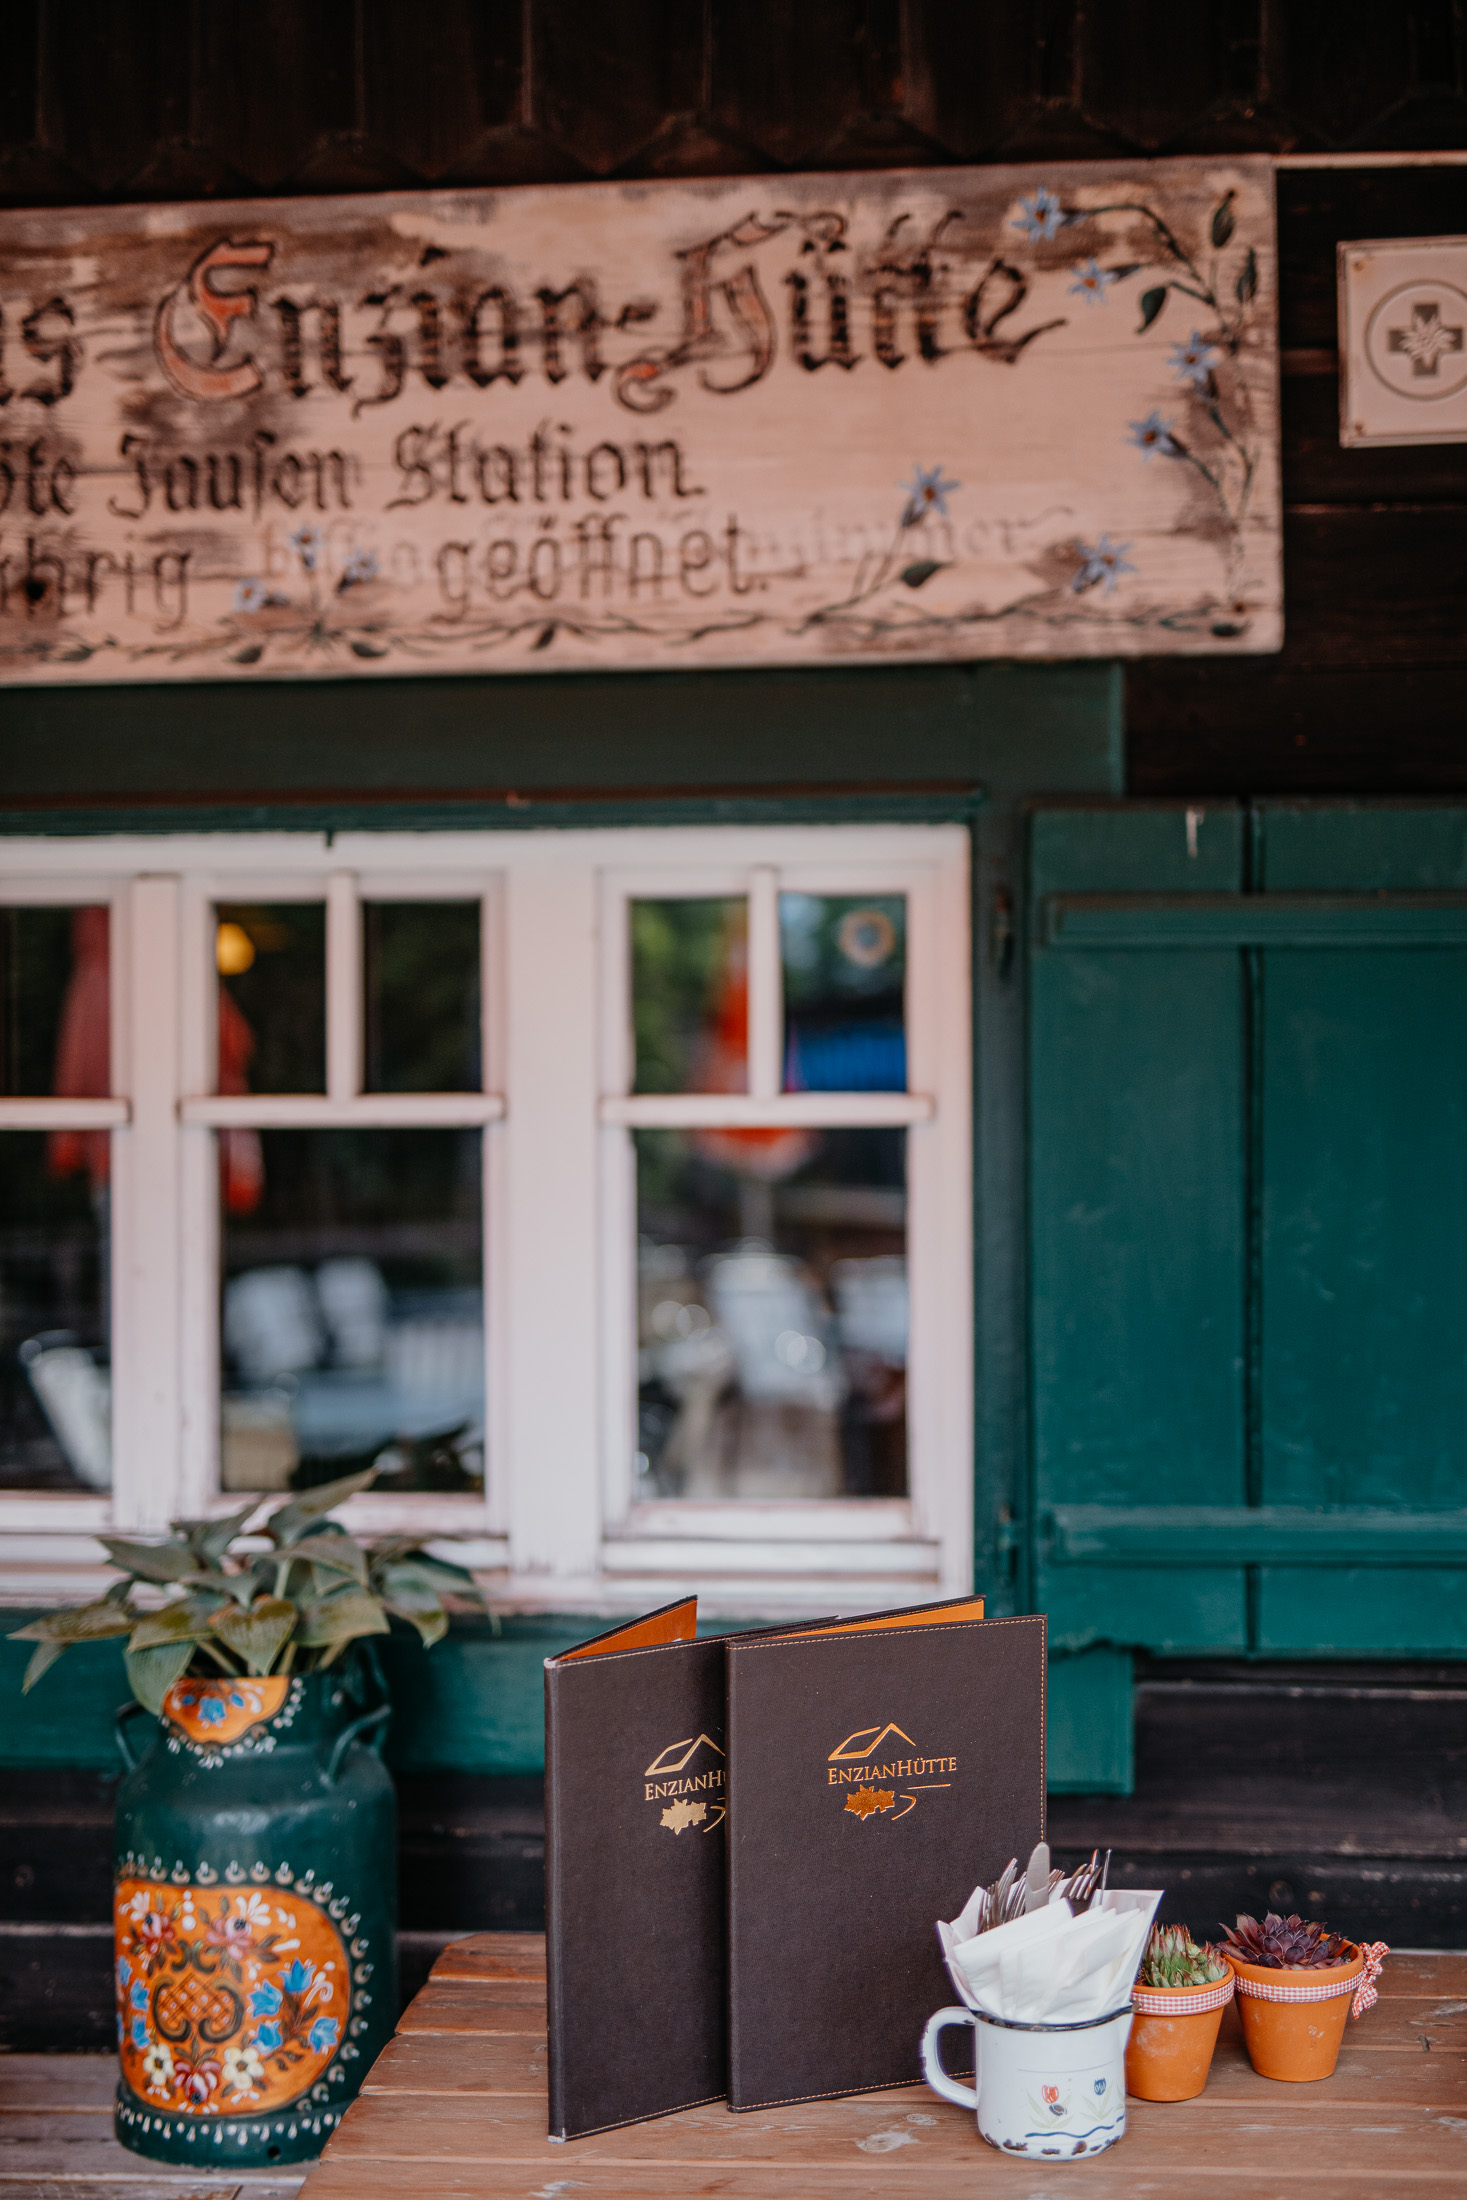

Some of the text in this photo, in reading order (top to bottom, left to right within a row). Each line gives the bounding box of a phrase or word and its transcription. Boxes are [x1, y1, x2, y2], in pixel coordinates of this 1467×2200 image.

[0, 296, 80, 406] s
[384, 419, 705, 510] Station
[644, 1769, 725, 1801] ENZIANH
[827, 1756, 958, 1785] ENZIANHÜTTE
